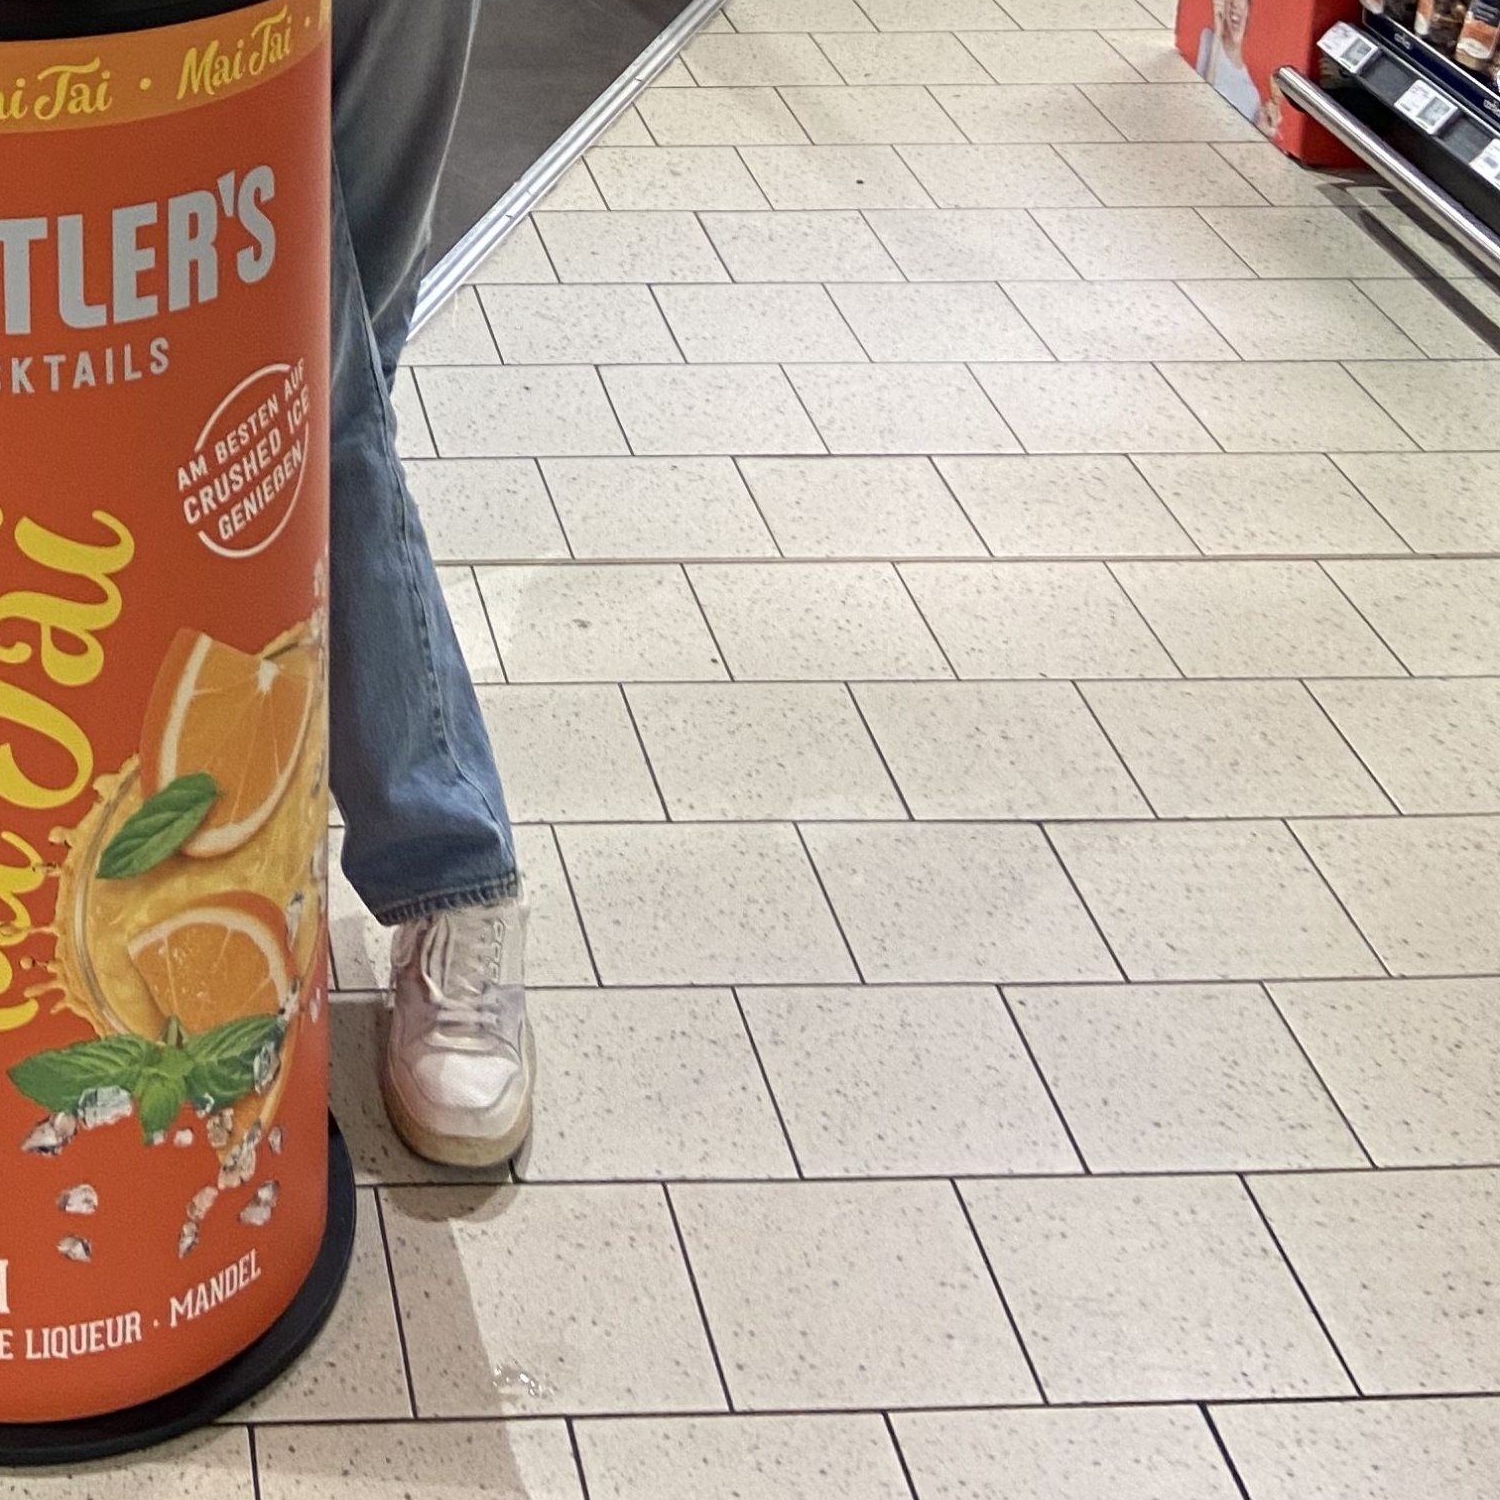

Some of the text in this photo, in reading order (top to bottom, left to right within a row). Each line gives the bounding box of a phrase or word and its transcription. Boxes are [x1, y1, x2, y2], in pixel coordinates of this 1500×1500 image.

[33, 59, 113, 122] Tai
[177, 4, 295, 100] Mai Tai
[177, 357, 304, 492] AM BESTEN AUF
[183, 383, 311, 525] CRUSHED ICE
[218, 439, 303, 541] GENIEßEN
[25, 1311, 142, 1361] LIQUEUR
[169, 1248, 262, 1329] MANDEL
